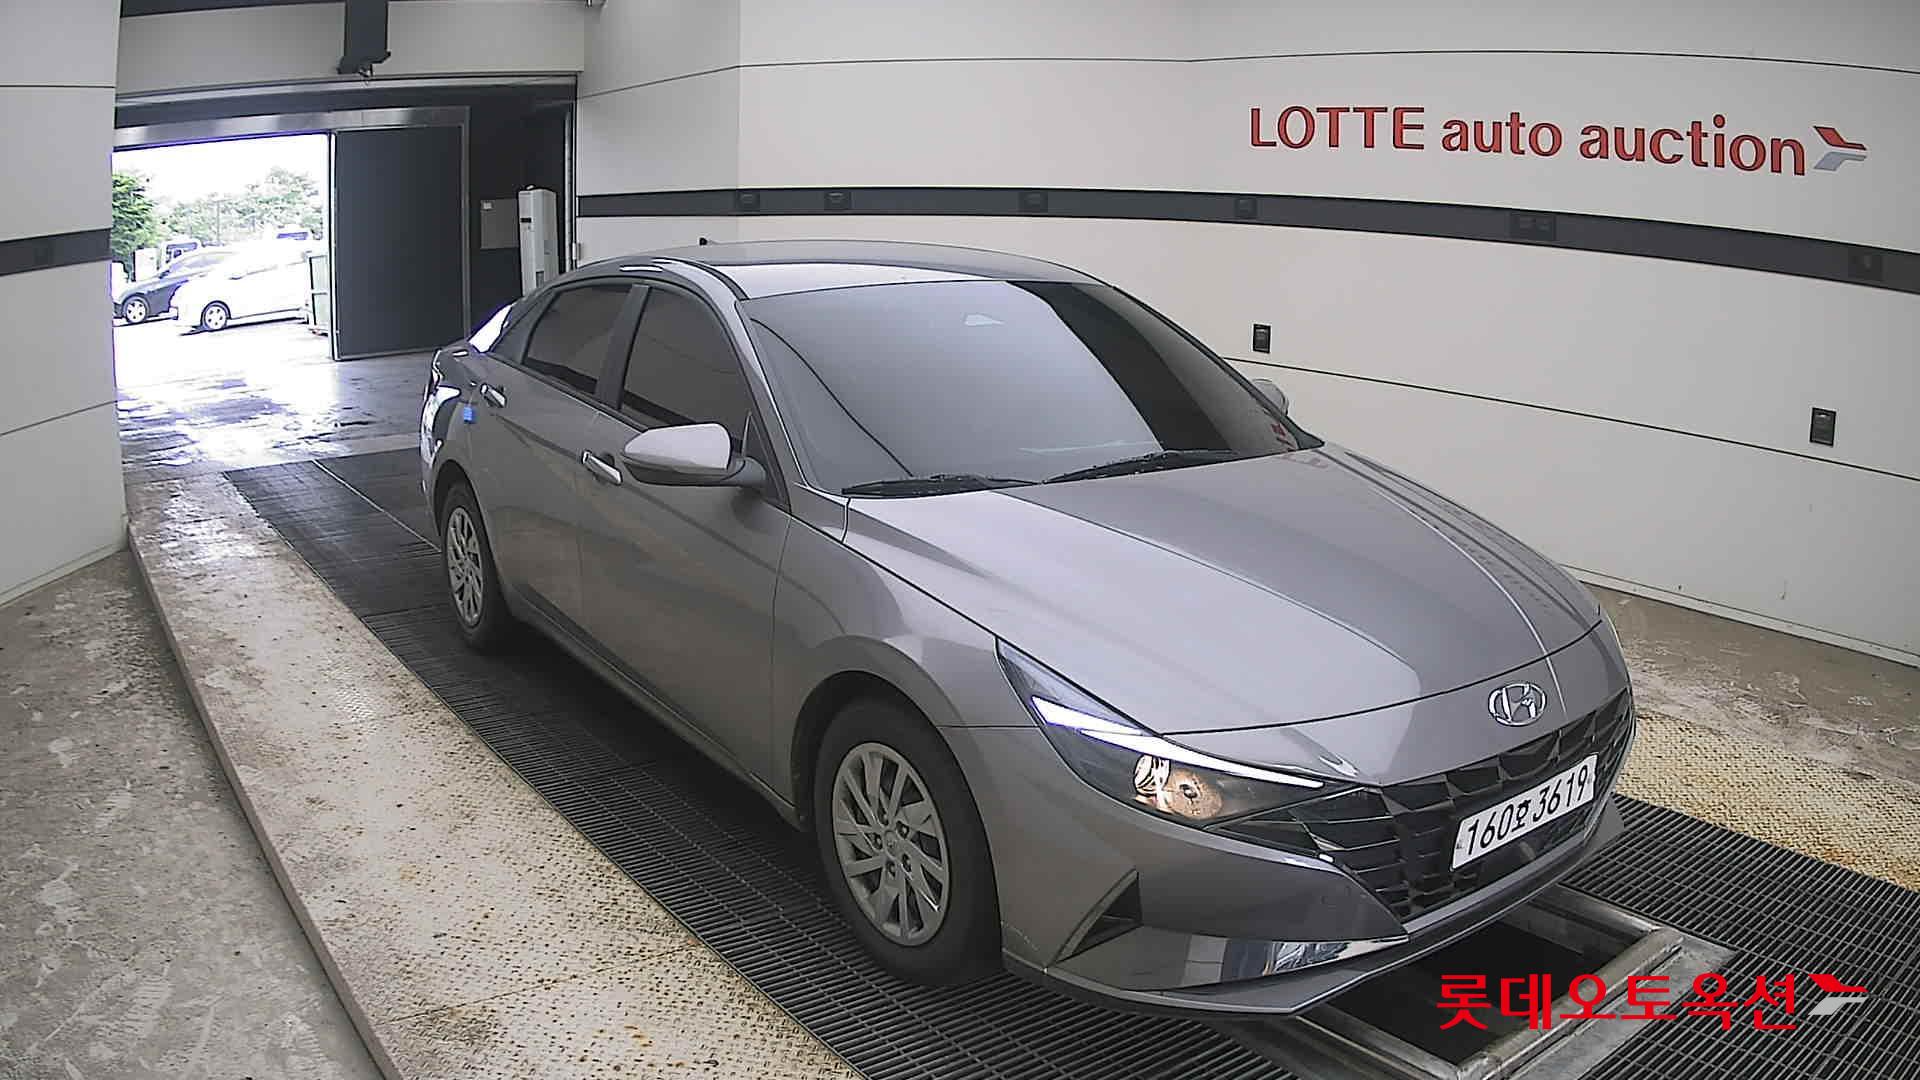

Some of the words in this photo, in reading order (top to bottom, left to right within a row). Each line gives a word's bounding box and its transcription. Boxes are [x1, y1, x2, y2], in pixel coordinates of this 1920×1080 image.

[1250, 105, 1425, 150] LOTTE
[1440, 111, 1562, 157] auto
[1579, 114, 1806, 176] auction
